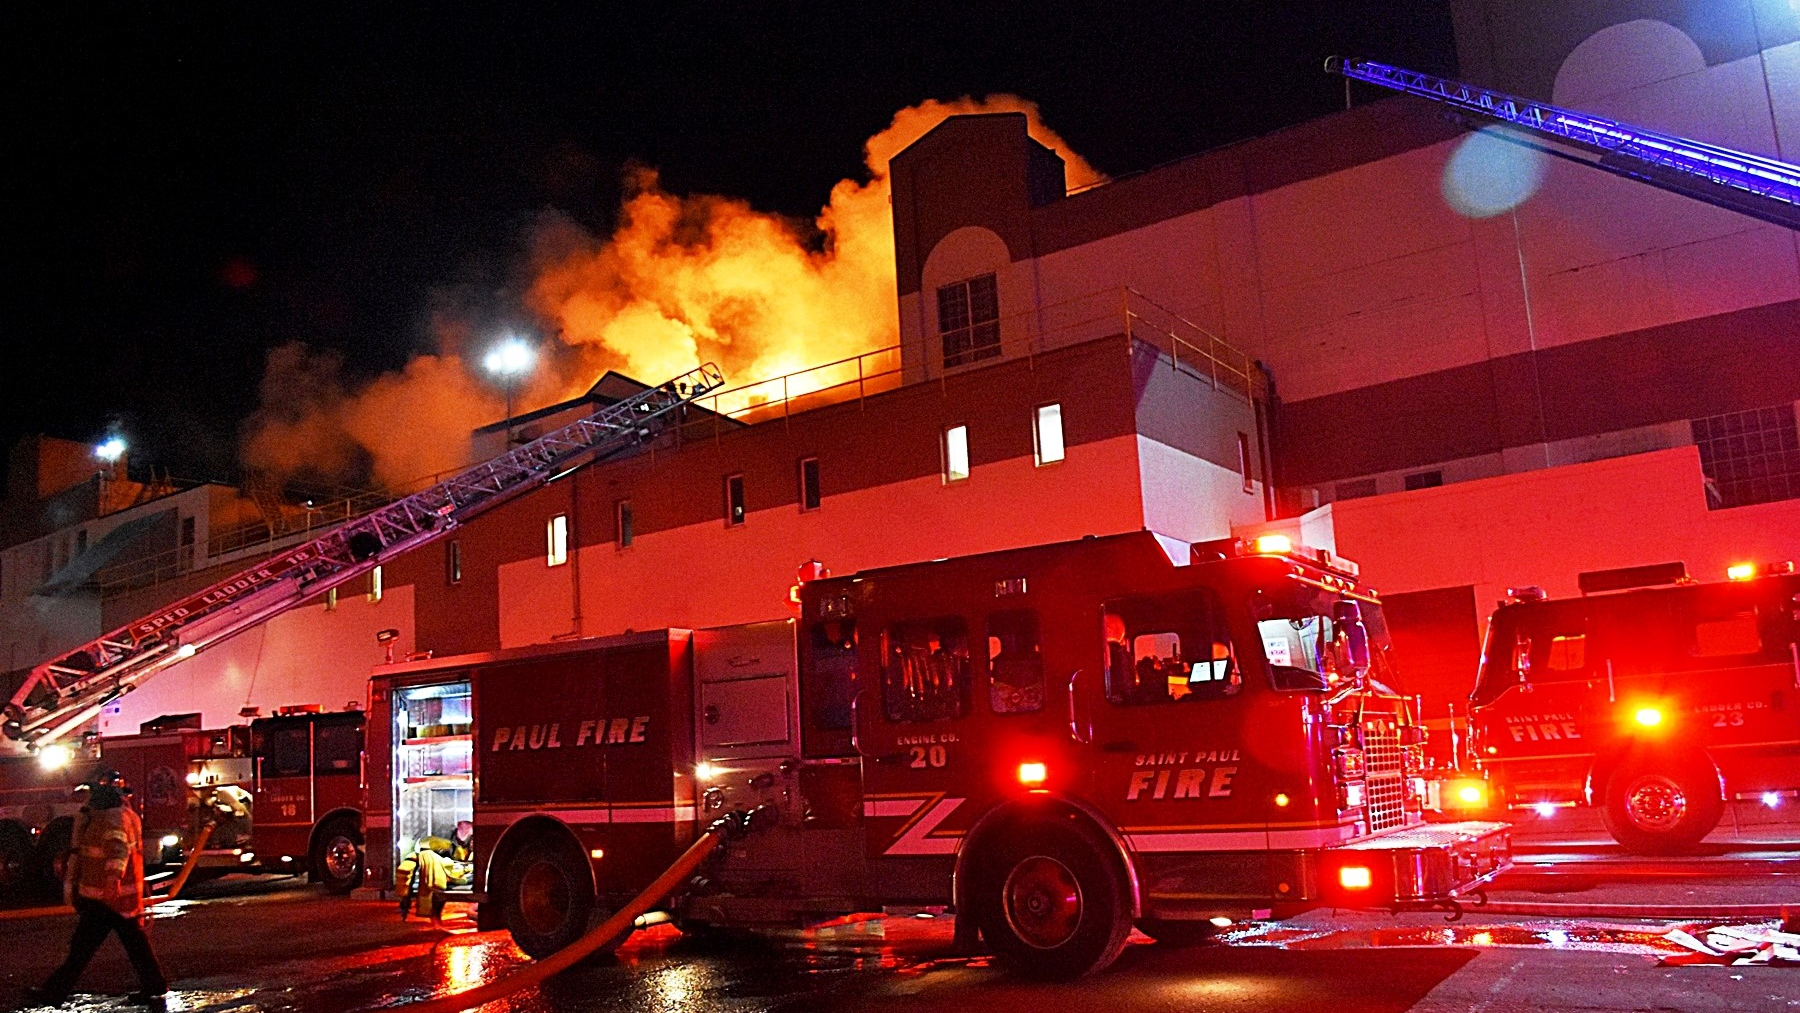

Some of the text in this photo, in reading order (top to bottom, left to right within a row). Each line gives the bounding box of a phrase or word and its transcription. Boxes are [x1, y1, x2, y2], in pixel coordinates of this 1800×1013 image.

[140, 552, 309, 633] SPFD LADDER 18
[1505, 711, 1574, 723] SAINT PAUL
[1712, 712, 1744, 727] 23
[492, 716, 650, 751] PAUL FIRE
[897, 733, 960, 745] ENGINE CO.
[1509, 722, 1581, 742] FIRE
[910, 745, 946, 768] 20
[1135, 750, 1241, 766] SAINT PAUL
[1127, 767, 1238, 800] FIRE
